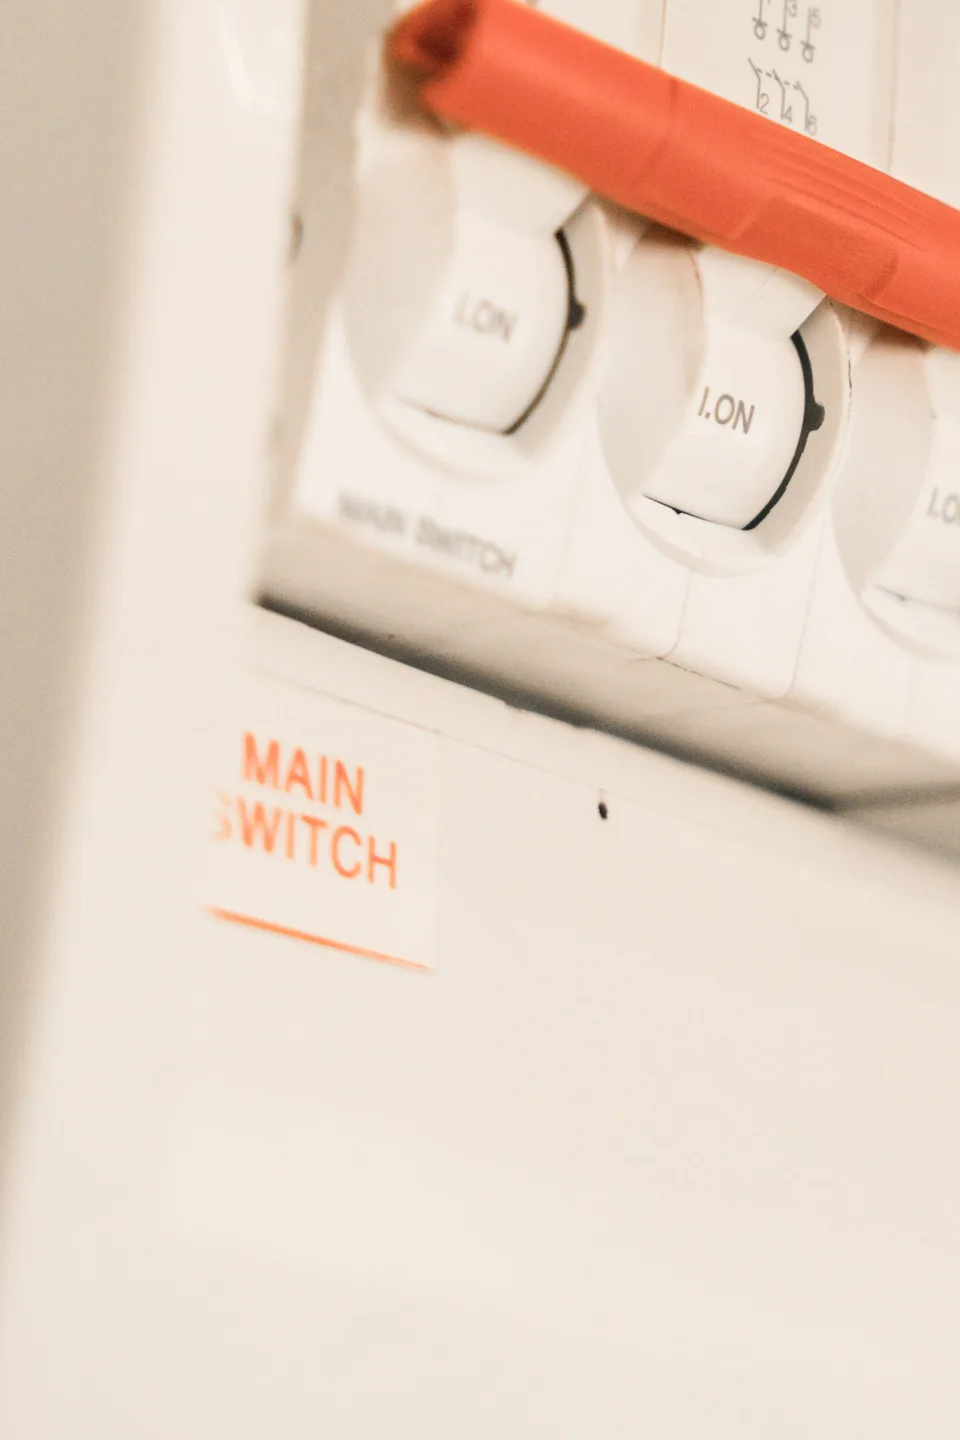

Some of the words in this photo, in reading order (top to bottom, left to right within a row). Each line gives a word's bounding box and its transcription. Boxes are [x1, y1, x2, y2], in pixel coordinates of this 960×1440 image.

[415, 513, 518, 578] SWITCH
[242, 730, 364, 816] MAIN
[213, 789, 397, 890] SWITCH
